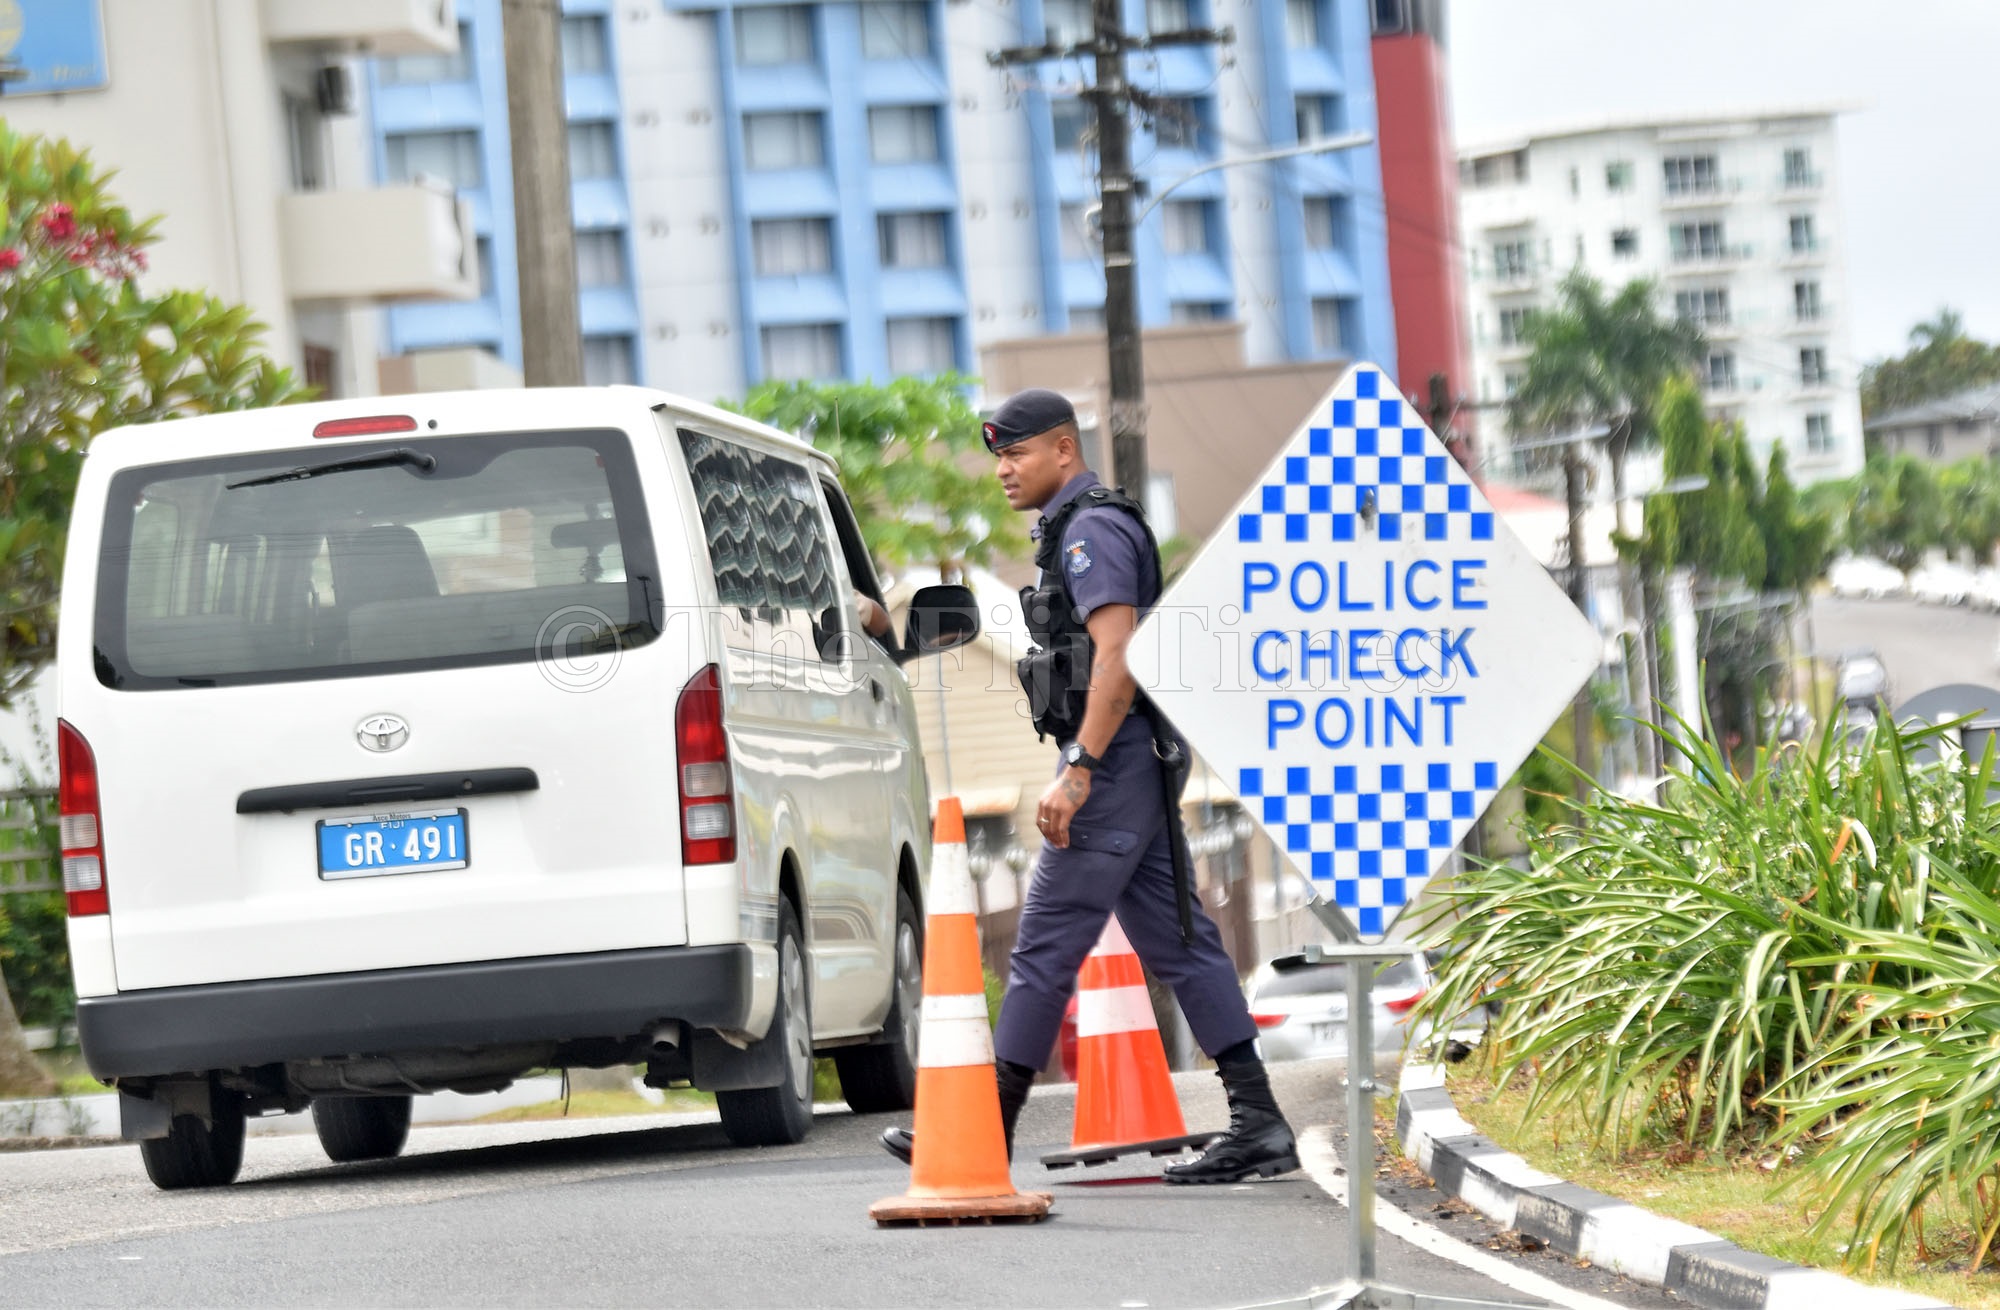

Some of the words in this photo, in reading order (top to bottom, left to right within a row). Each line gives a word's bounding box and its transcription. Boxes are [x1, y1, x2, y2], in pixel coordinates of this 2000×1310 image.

[1243, 559, 1488, 613] POLICE
[1252, 627, 1480, 682] CHECK
[1268, 696, 1466, 750] POINT
